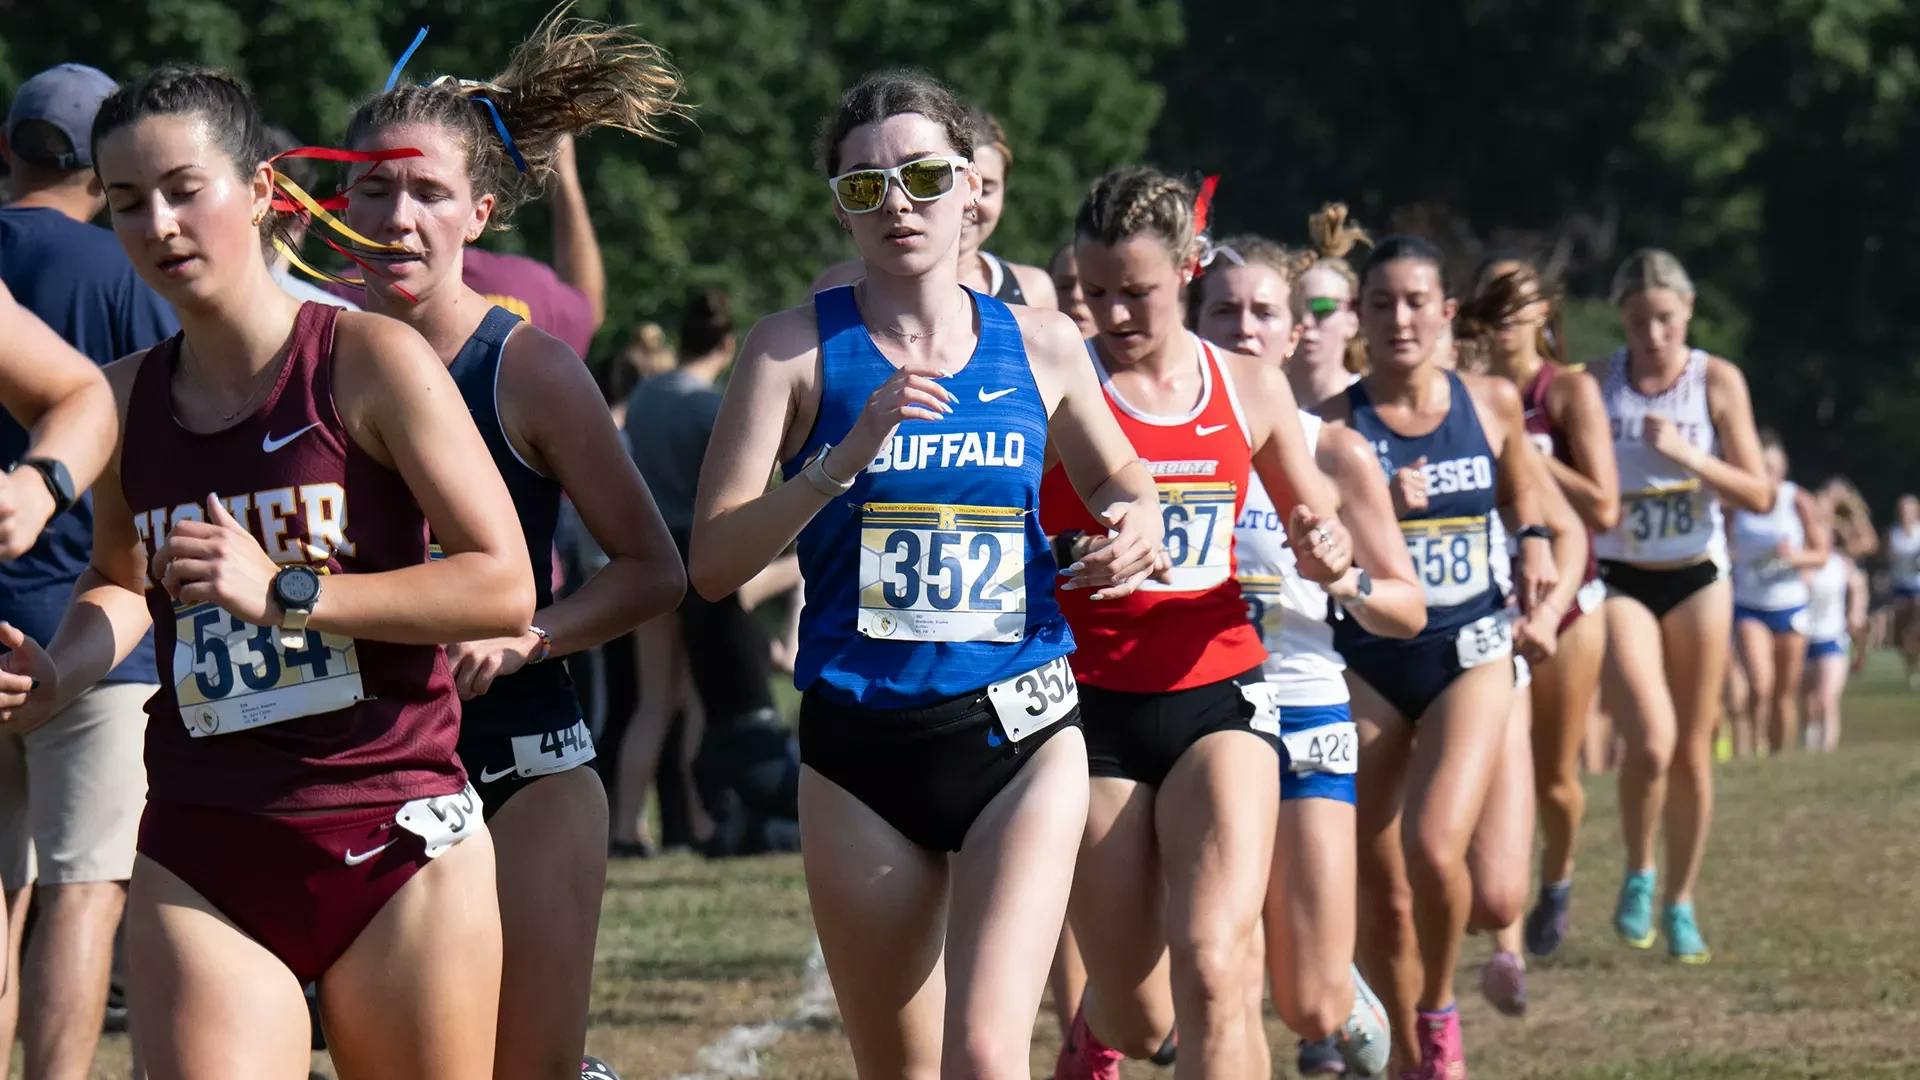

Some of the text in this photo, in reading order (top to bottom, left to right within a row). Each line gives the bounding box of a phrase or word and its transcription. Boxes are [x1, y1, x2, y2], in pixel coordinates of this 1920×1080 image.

[867, 431, 1025, 474] BUFFALO
[1162, 505, 1218, 567] 67
[1631, 495, 1694, 540] 378
[882, 530, 1003, 611] 352
[193, 609, 332, 700] 534
[1015, 655, 1075, 717] 352
